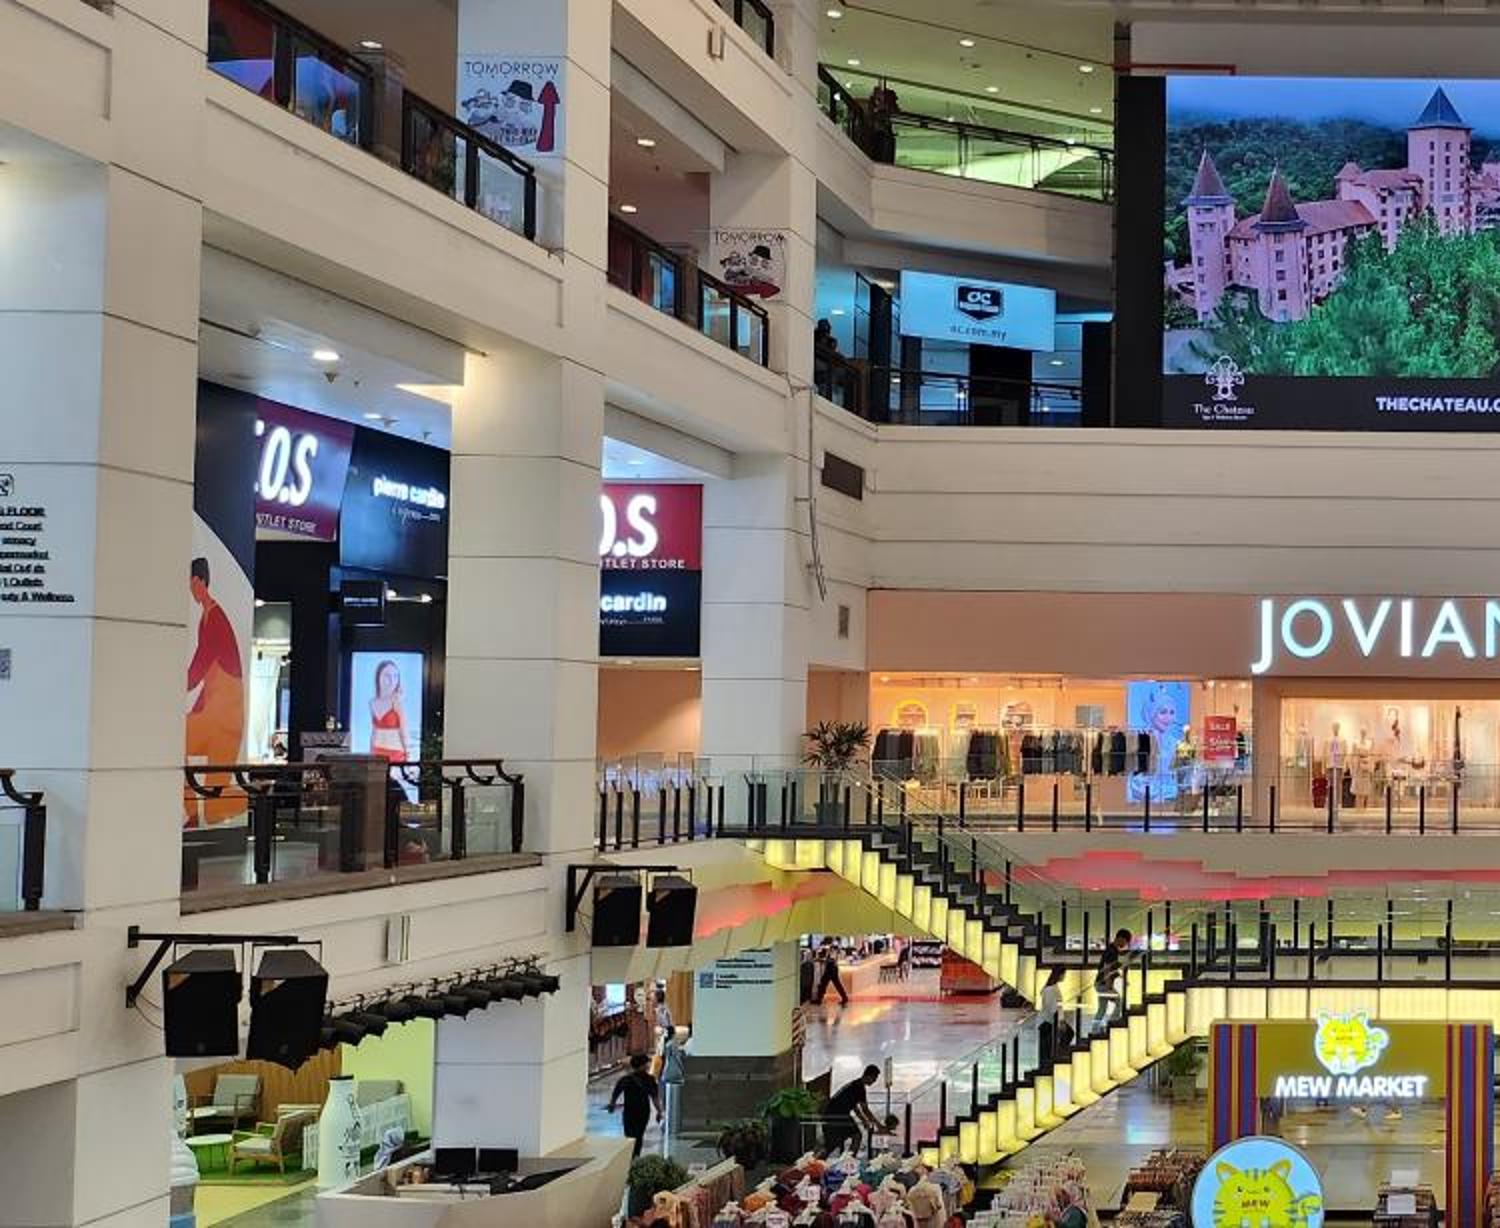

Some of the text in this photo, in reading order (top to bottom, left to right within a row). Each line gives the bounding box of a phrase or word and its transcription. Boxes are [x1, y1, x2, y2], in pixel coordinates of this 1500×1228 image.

[464, 62, 559, 75] TOMORROW
[256, 420, 318, 506] .O.S
[600, 559, 685, 569] TLET STORE
[601, 592, 667, 612] cardin
[1275, 1075, 1428, 1098] MEW MARKET
